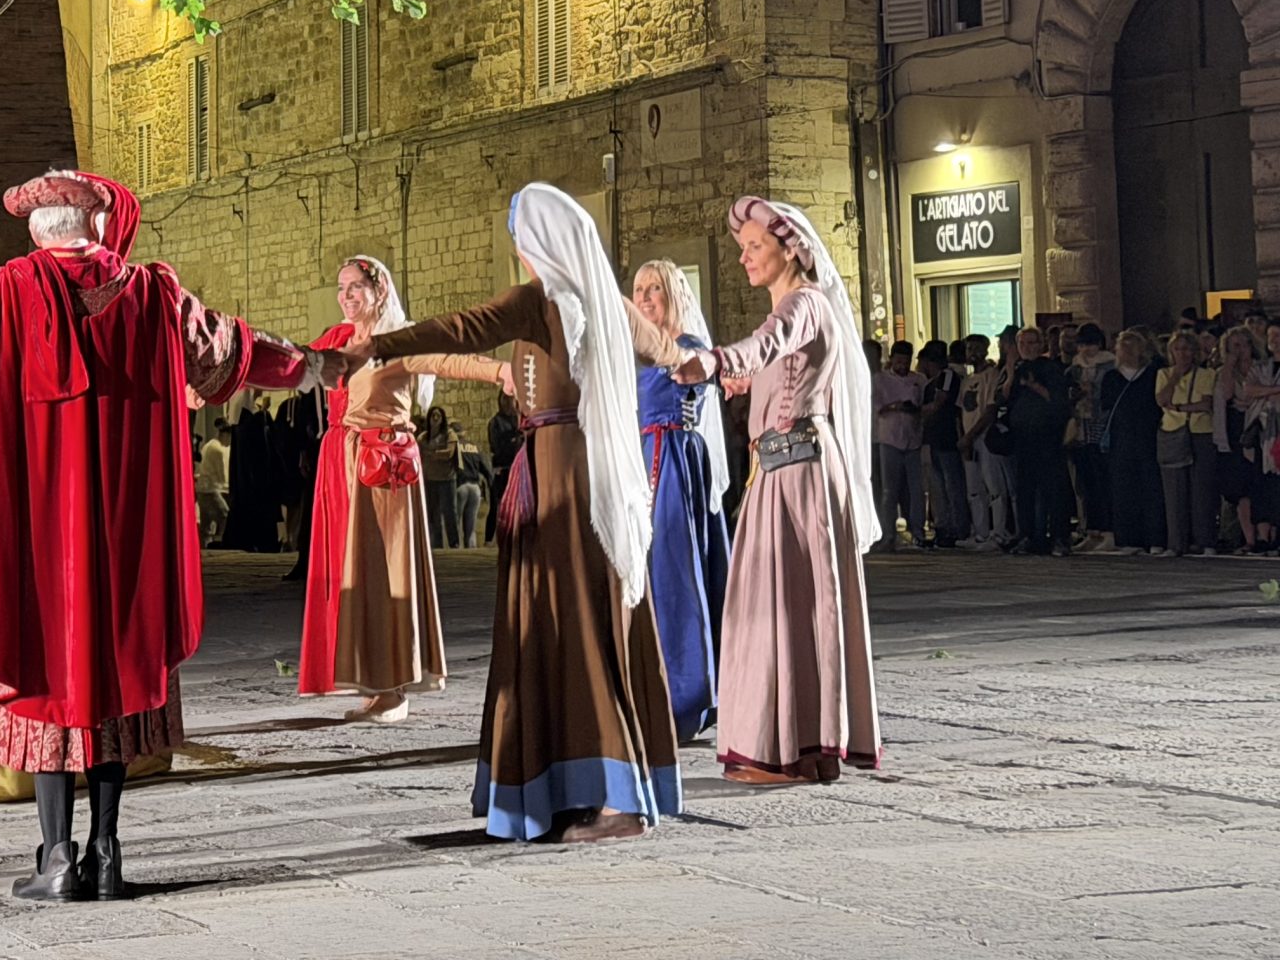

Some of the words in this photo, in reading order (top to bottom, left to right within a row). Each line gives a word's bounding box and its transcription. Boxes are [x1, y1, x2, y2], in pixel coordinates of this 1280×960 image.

[918, 191, 986, 222] L'ARTIGIANO
[988, 190, 1010, 214] DEL
[936, 220, 994, 252] GELATO
